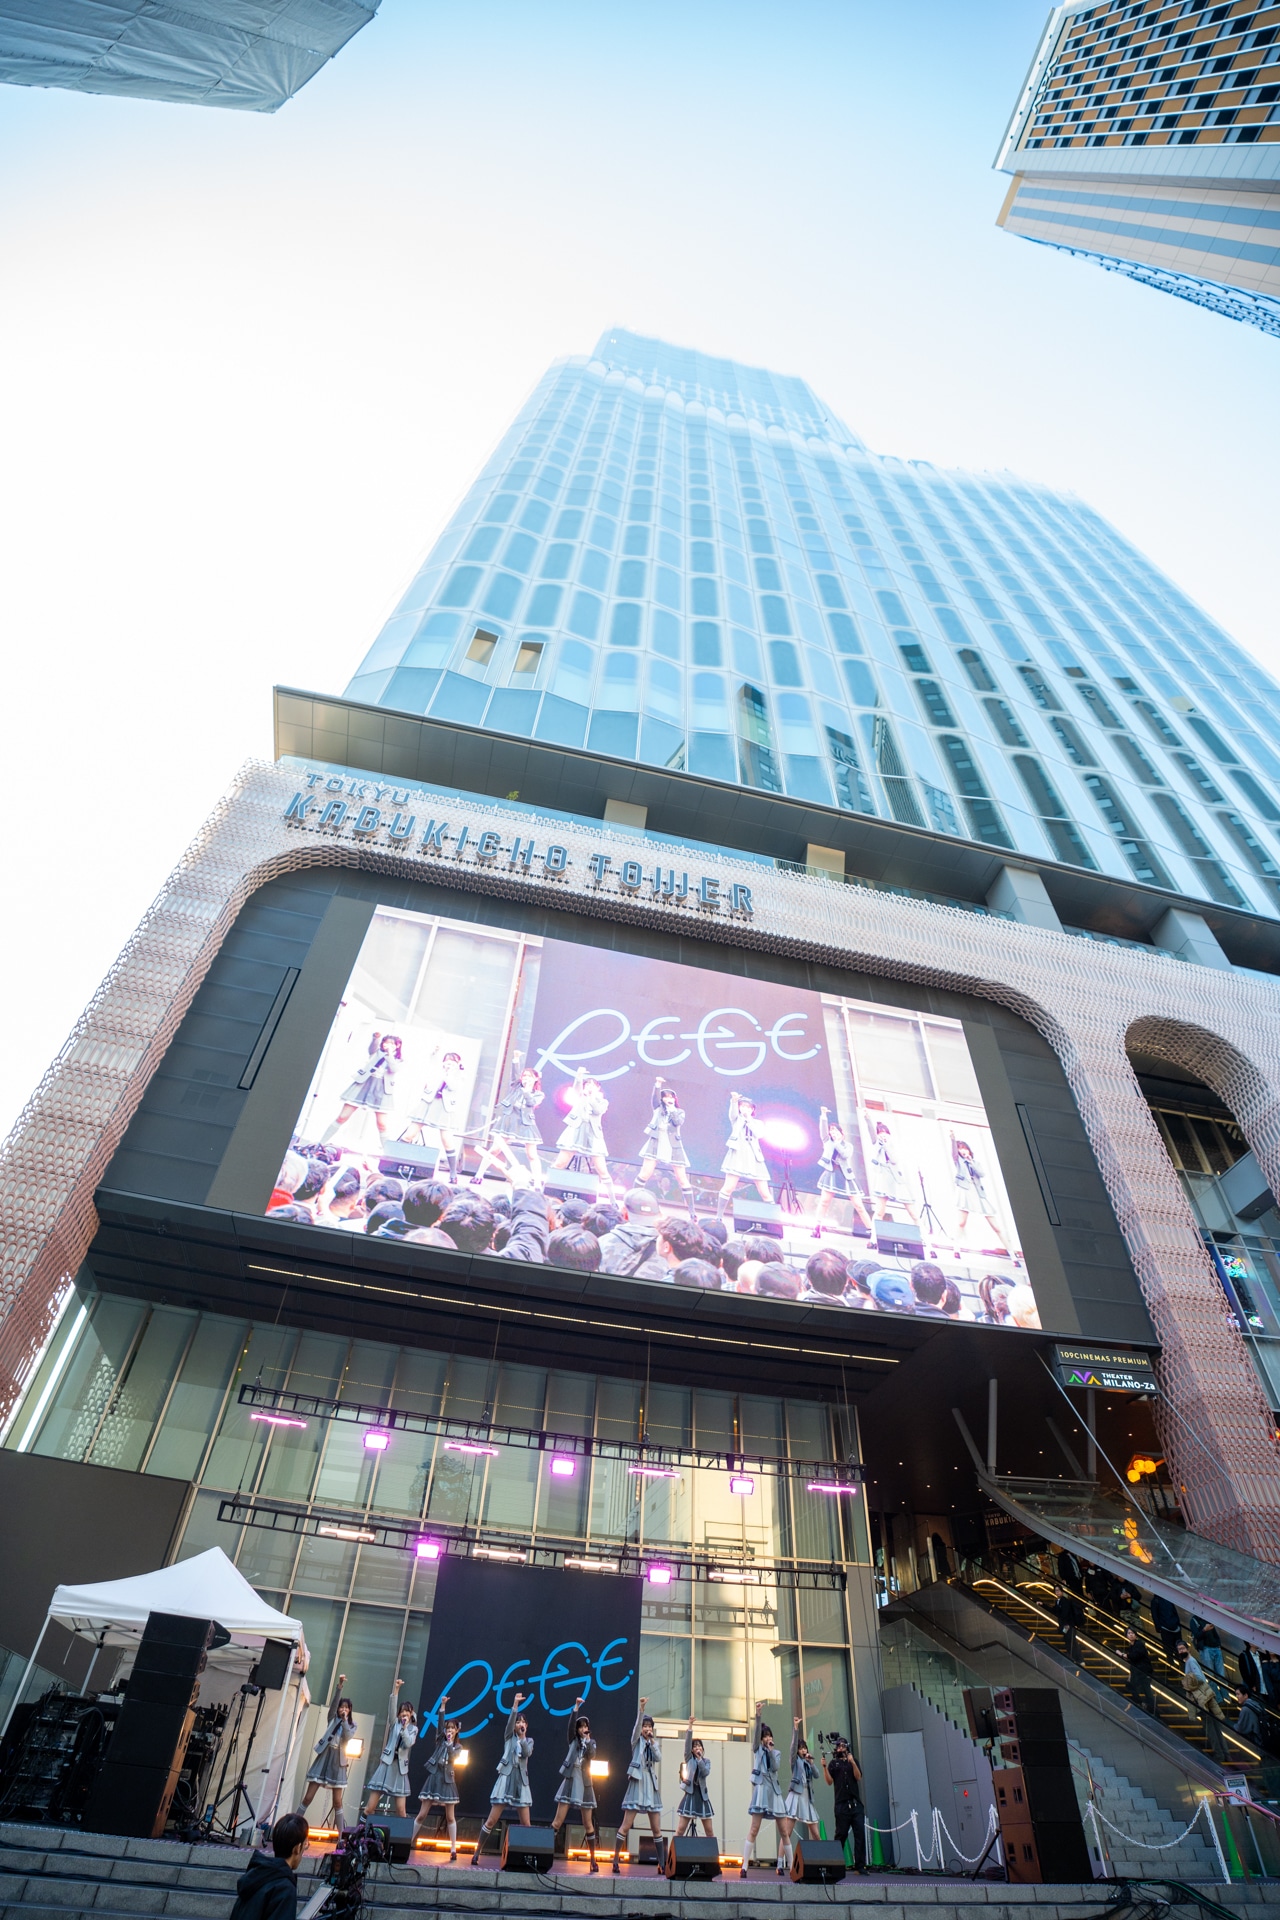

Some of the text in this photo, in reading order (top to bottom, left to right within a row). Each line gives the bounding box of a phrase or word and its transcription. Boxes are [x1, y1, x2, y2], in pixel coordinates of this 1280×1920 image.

[306, 773, 410, 806] TOKYU
[283, 792, 755, 914] KABUKICHO TOWER
[1060, 1351, 1148, 1366] 109CINEMAS PREMIUM
[1101, 1372, 1133, 1380] THEATER
[1103, 1379, 1156, 1390] MILANO-Za
